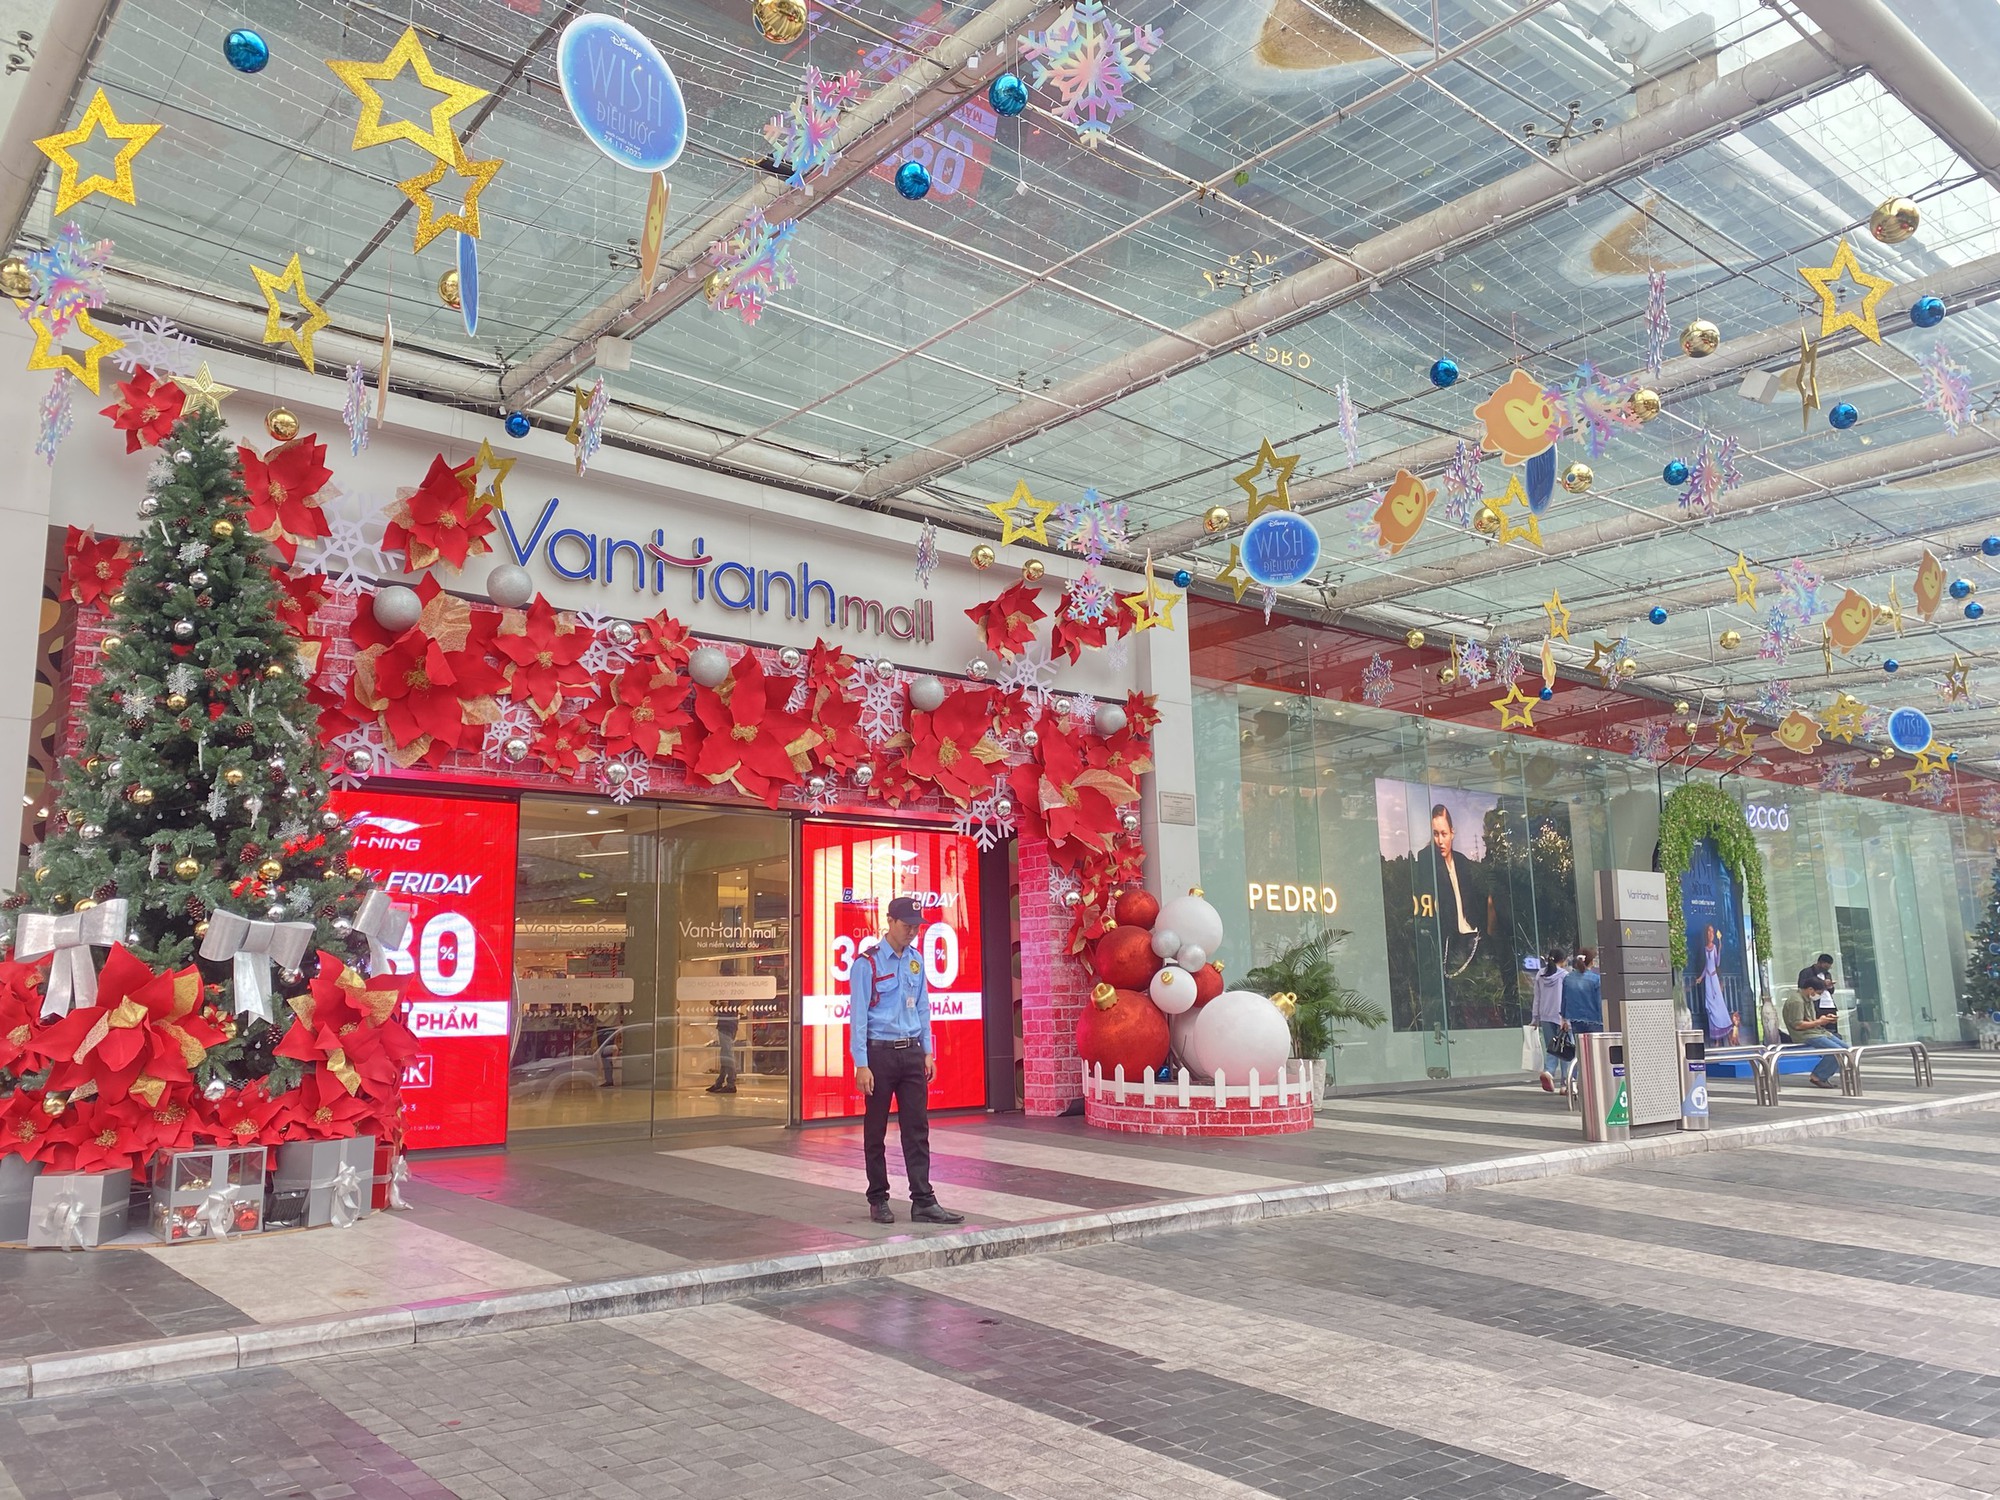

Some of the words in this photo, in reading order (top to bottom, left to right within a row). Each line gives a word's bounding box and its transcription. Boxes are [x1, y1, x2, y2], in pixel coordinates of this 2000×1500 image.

[608, 29, 642, 60] Disney
[587, 39, 662, 127] WISH
[1254, 529, 1304, 558] WISH
[1896, 718, 1923, 736] WISH
[384, 871, 482, 895] FRIDAY
[1248, 883, 1338, 914] PEDRO
[416, 1005, 478, 1030] PHẨM
